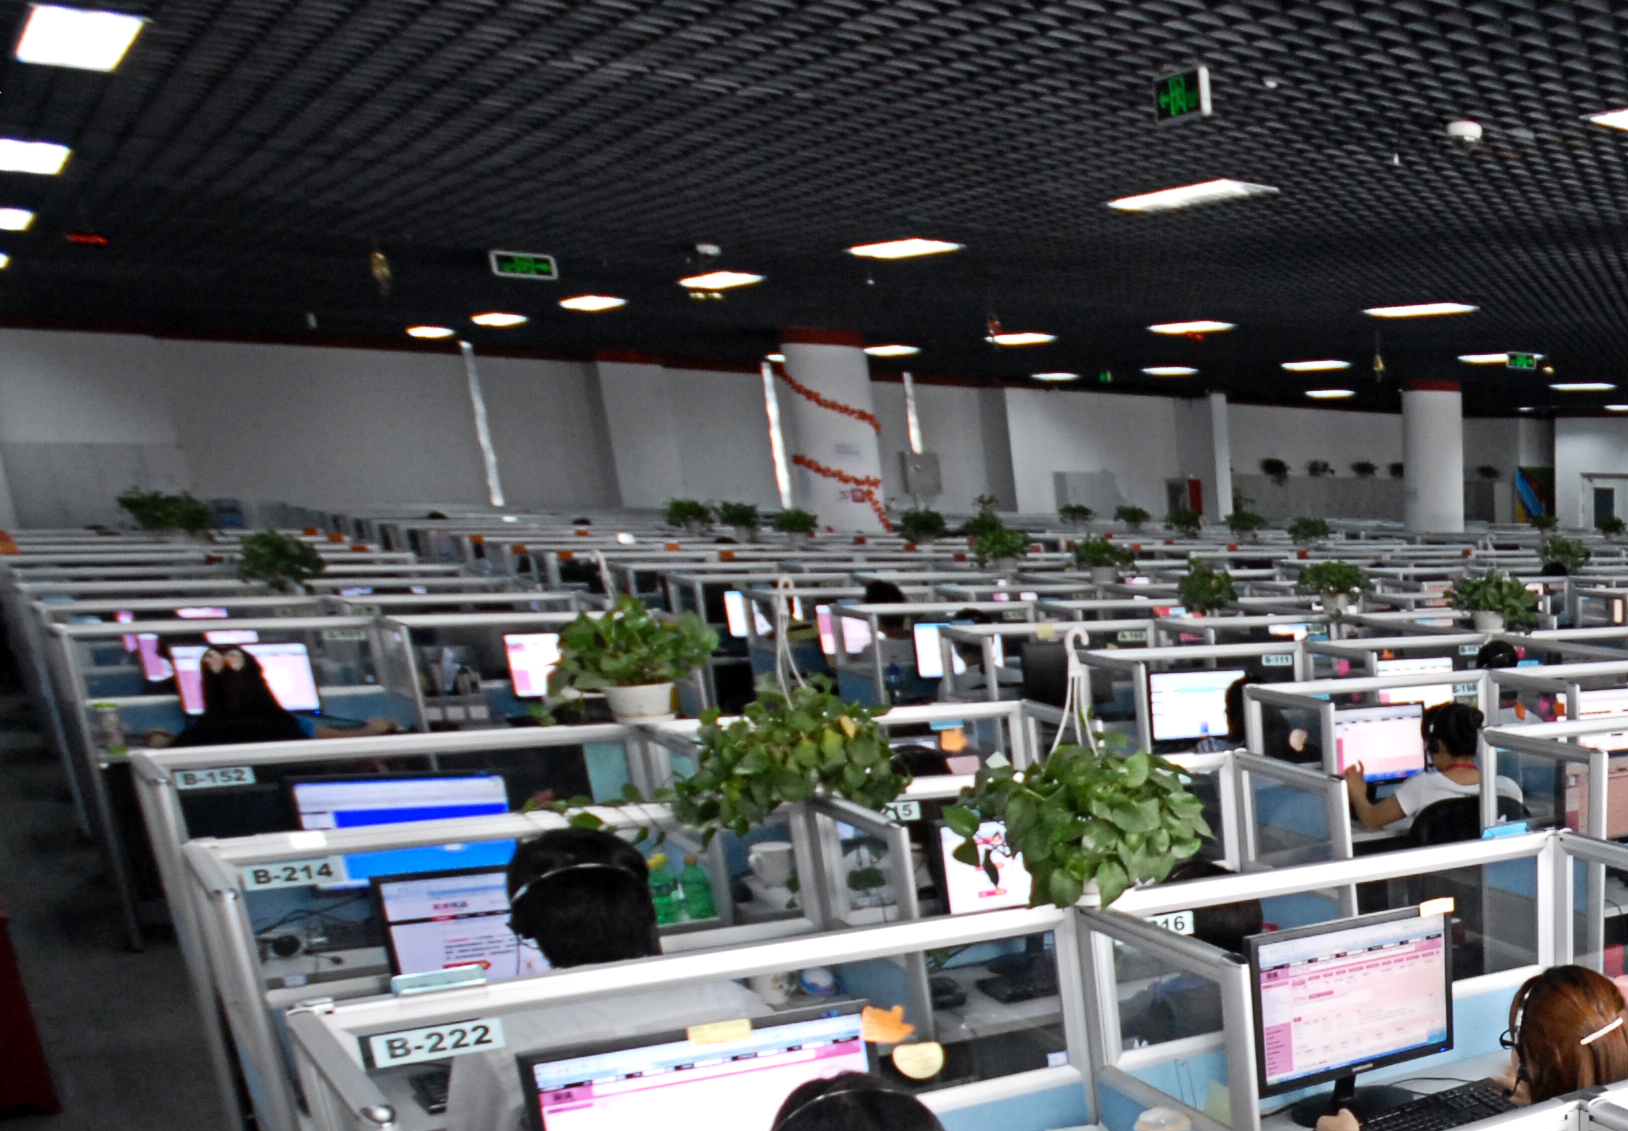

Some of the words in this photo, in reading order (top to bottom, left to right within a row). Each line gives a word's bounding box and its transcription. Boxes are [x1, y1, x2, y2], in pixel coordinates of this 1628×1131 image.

[182, 769, 247, 786] B-152
[252, 863, 334, 885] B-214
[386, 1025, 493, 1059] B-222
